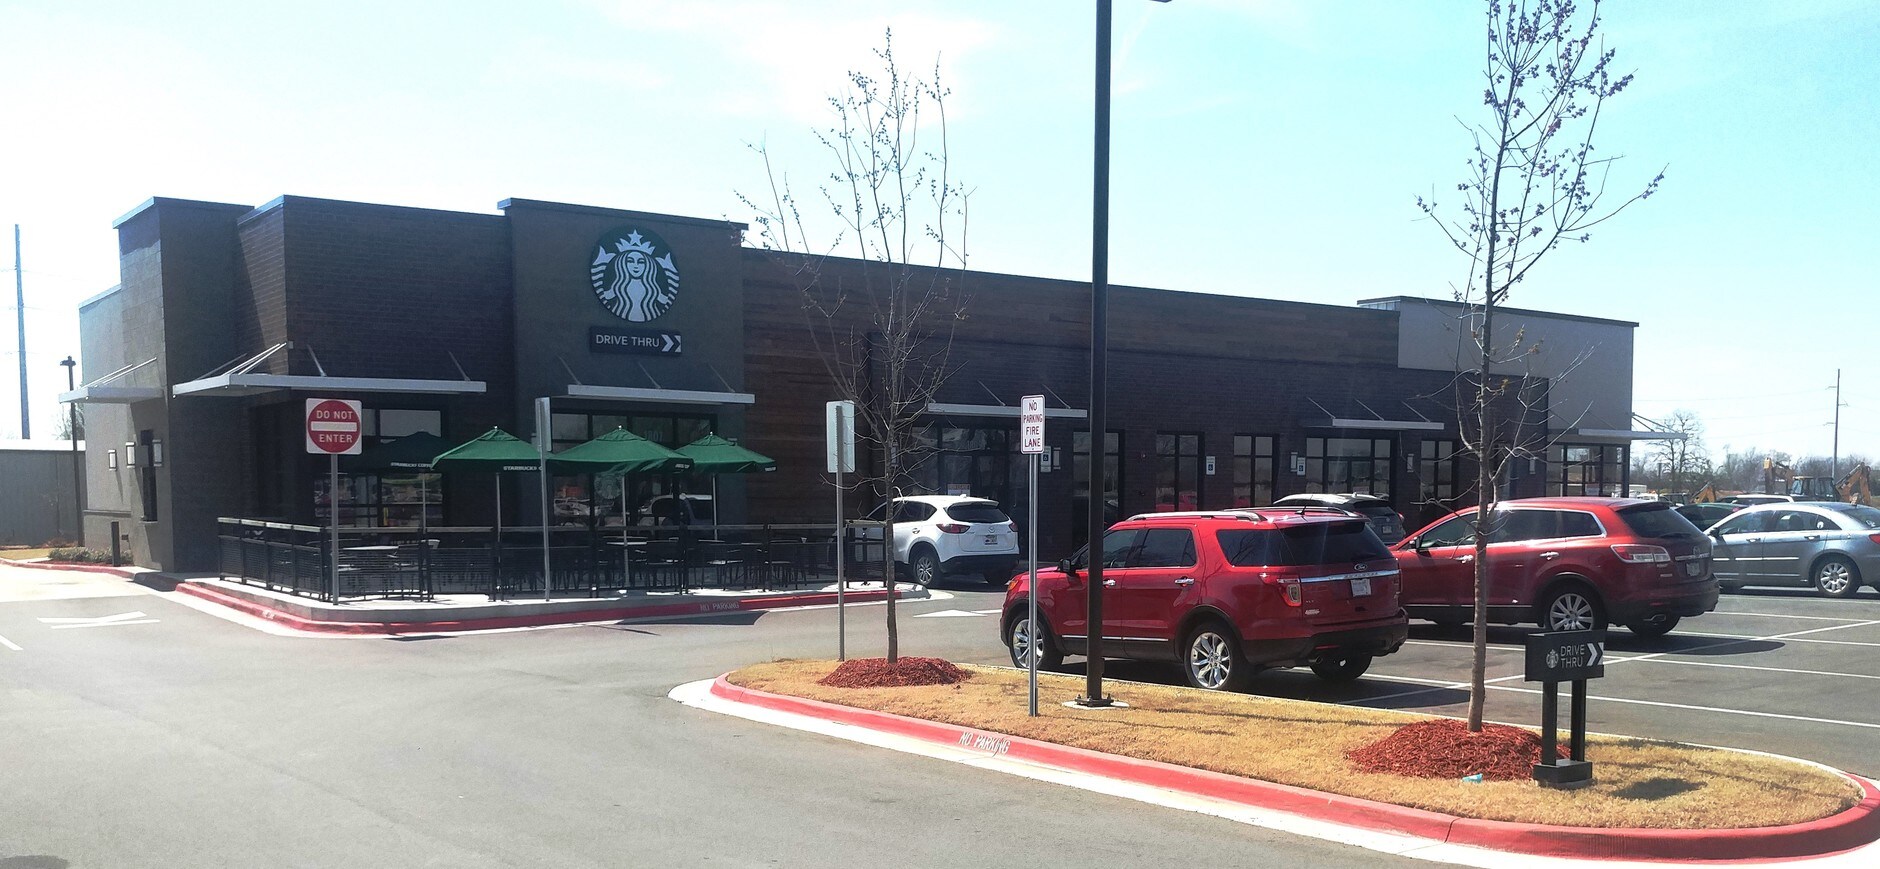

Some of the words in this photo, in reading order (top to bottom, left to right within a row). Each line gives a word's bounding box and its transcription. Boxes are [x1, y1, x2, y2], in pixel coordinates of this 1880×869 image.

[596, 334, 628, 345] DRIVE
[631, 336, 660, 347] THRU
[1028, 402, 1038, 411] NO
[316, 410, 330, 419] DO
[333, 411, 353, 419] NOT
[1023, 413, 1043, 423] PARKING
[1025, 426, 1040, 435] FIRE
[319, 434, 353, 443] ENTER
[1024, 438, 1041, 447] LANE
[1560, 644, 1585, 657] DRIVE
[1560, 656, 1583, 668] THRU
[958, 731, 974, 746] NO
[973, 734, 1011, 754] PARKING
